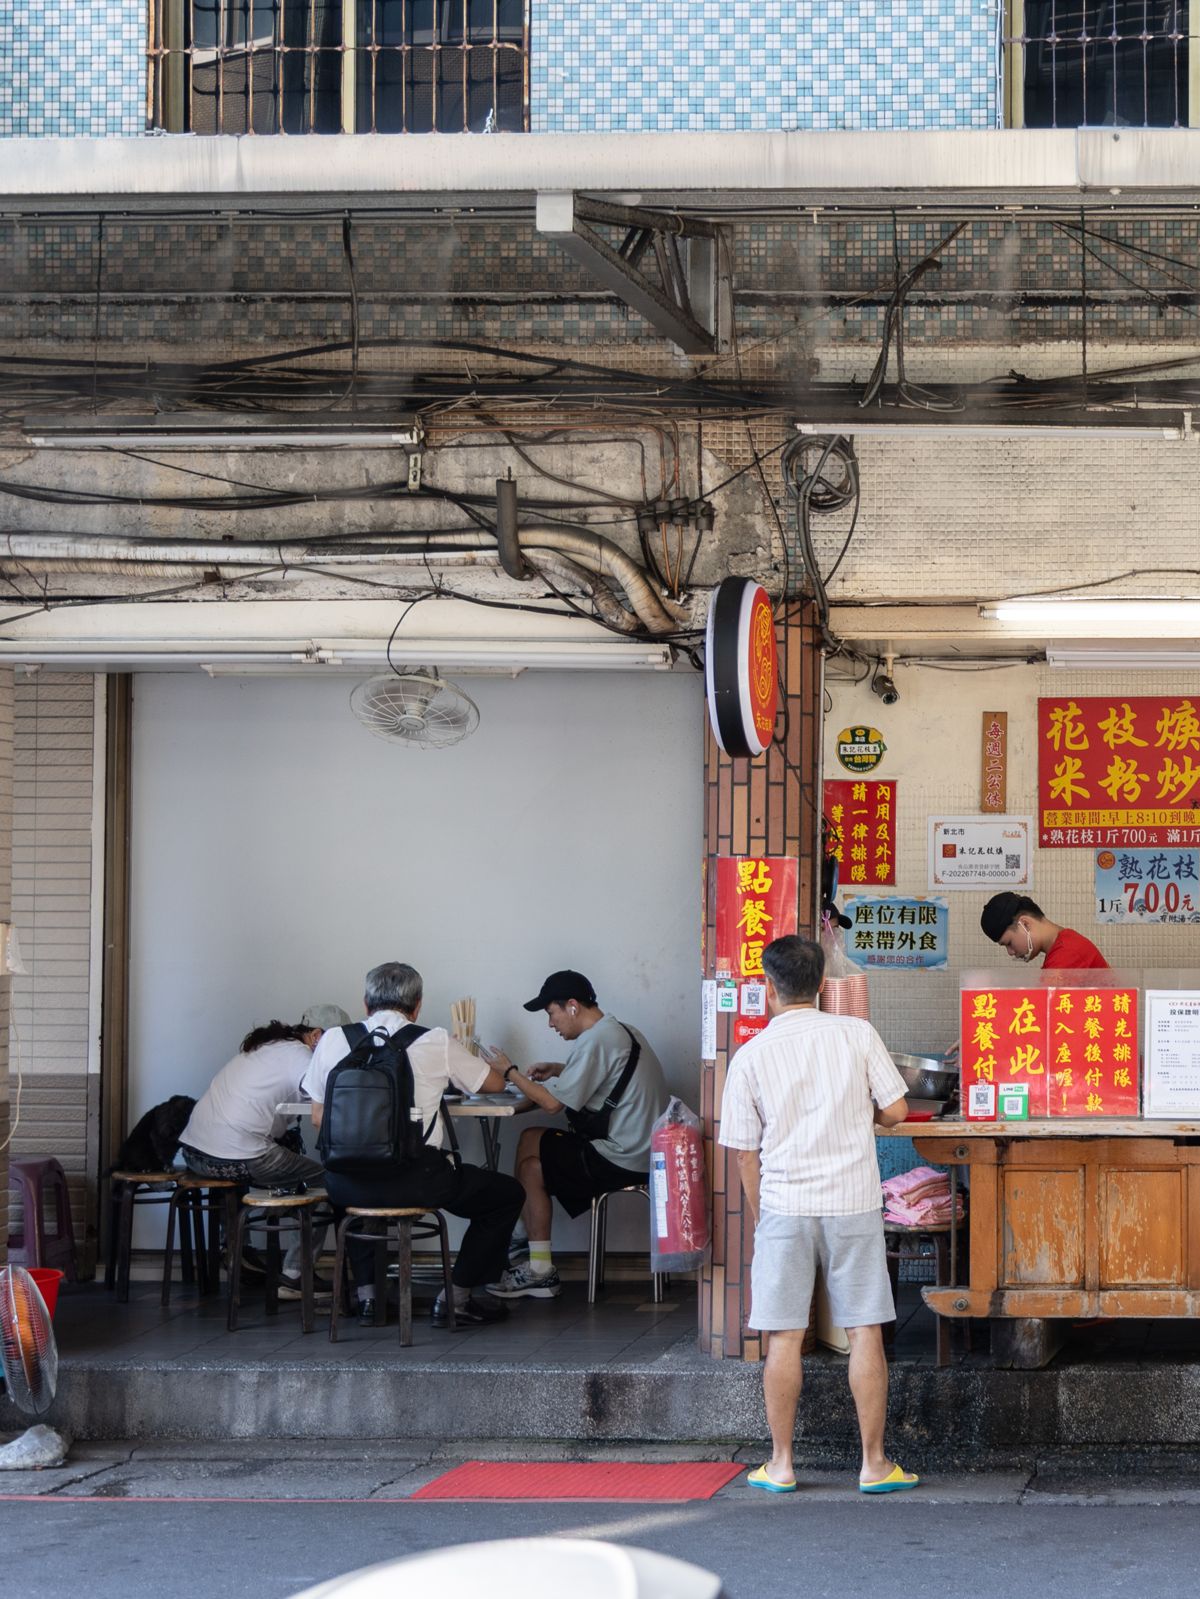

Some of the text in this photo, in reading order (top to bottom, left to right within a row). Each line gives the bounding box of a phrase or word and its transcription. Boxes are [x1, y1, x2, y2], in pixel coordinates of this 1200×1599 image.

[985, 721, 1005, 807] 每週二公休
[851, 782, 870, 881] 請一律排隊
[875, 784, 892, 882] 內用及外帶
[943, 828, 965, 836] 新北市
[1118, 853, 1199, 881] 熟花枝
[736, 860, 773, 977] 點餐區
[855, 905, 937, 925] 座位有限
[1099, 896, 1123, 913] 1斤
[854, 931, 937, 951] 禁帶外食
[867, 954, 925, 965] 感謝您的合作
[1008, 997, 1045, 1076] 在此
[1083, 995, 1104, 1113] 點餐後付款
[1112, 994, 1132, 1088] 請先排隊
[689, 1144, 699, 1182] 三重區
